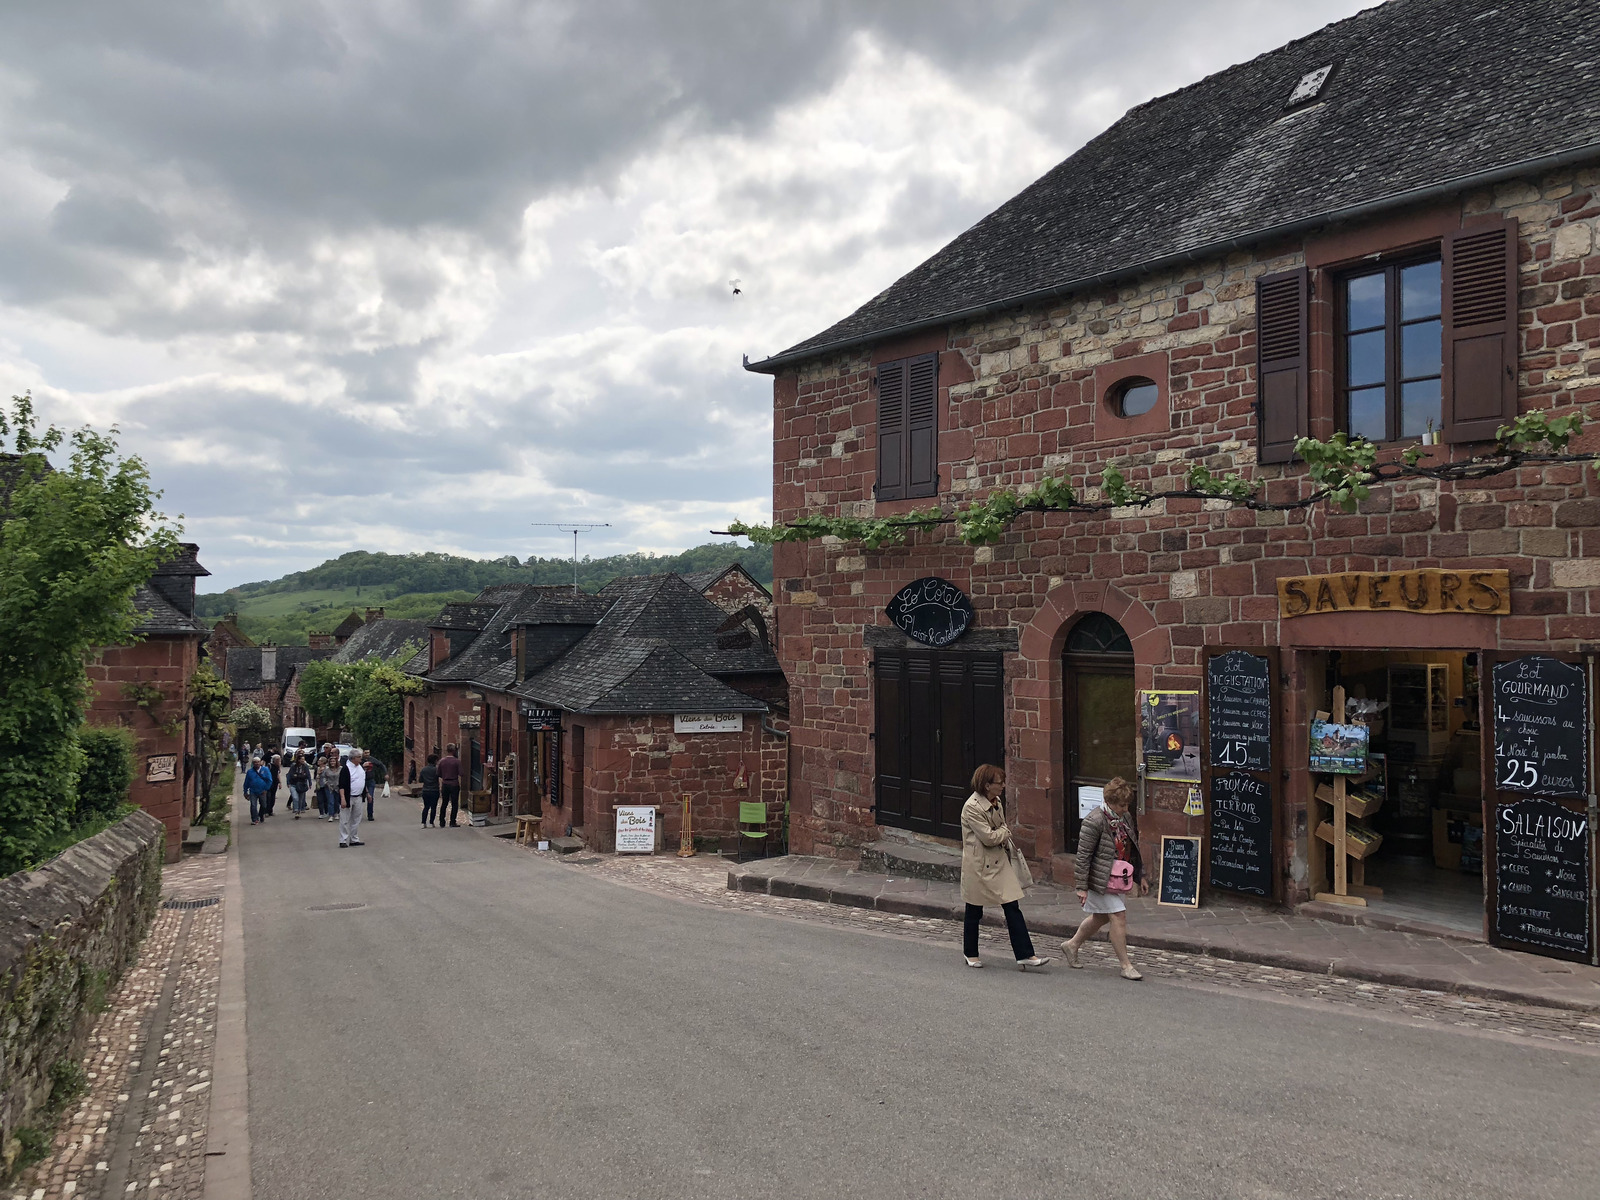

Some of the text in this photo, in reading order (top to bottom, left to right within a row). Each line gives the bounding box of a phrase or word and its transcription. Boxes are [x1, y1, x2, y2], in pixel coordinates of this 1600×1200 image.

[1285, 572, 1501, 615] SAVEURS
[1225, 656, 1244, 672] Lot
[1517, 662, 1543, 679] Lot
[680, 714, 701, 723] Viens
[714, 713, 737, 723] Bois
[1498, 705, 1575, 728] 4 saucissons au
[1219, 741, 1248, 766] 15
[1496, 742, 1505, 757] 1
[1531, 746, 1539, 758] de
[1542, 746, 1569, 766] jambon
[1501, 759, 1575, 789] 25 euros
[1216, 778, 1264, 795] FROMAGE
[1215, 799, 1256, 815] TERROIR
[628, 816, 646, 825] Bois
[1502, 808, 1586, 840] SALAISON
[1554, 841, 1564, 853] de
[1509, 863, 1530, 875] CEPES
[1526, 923, 1553, 937] FROMAGE
